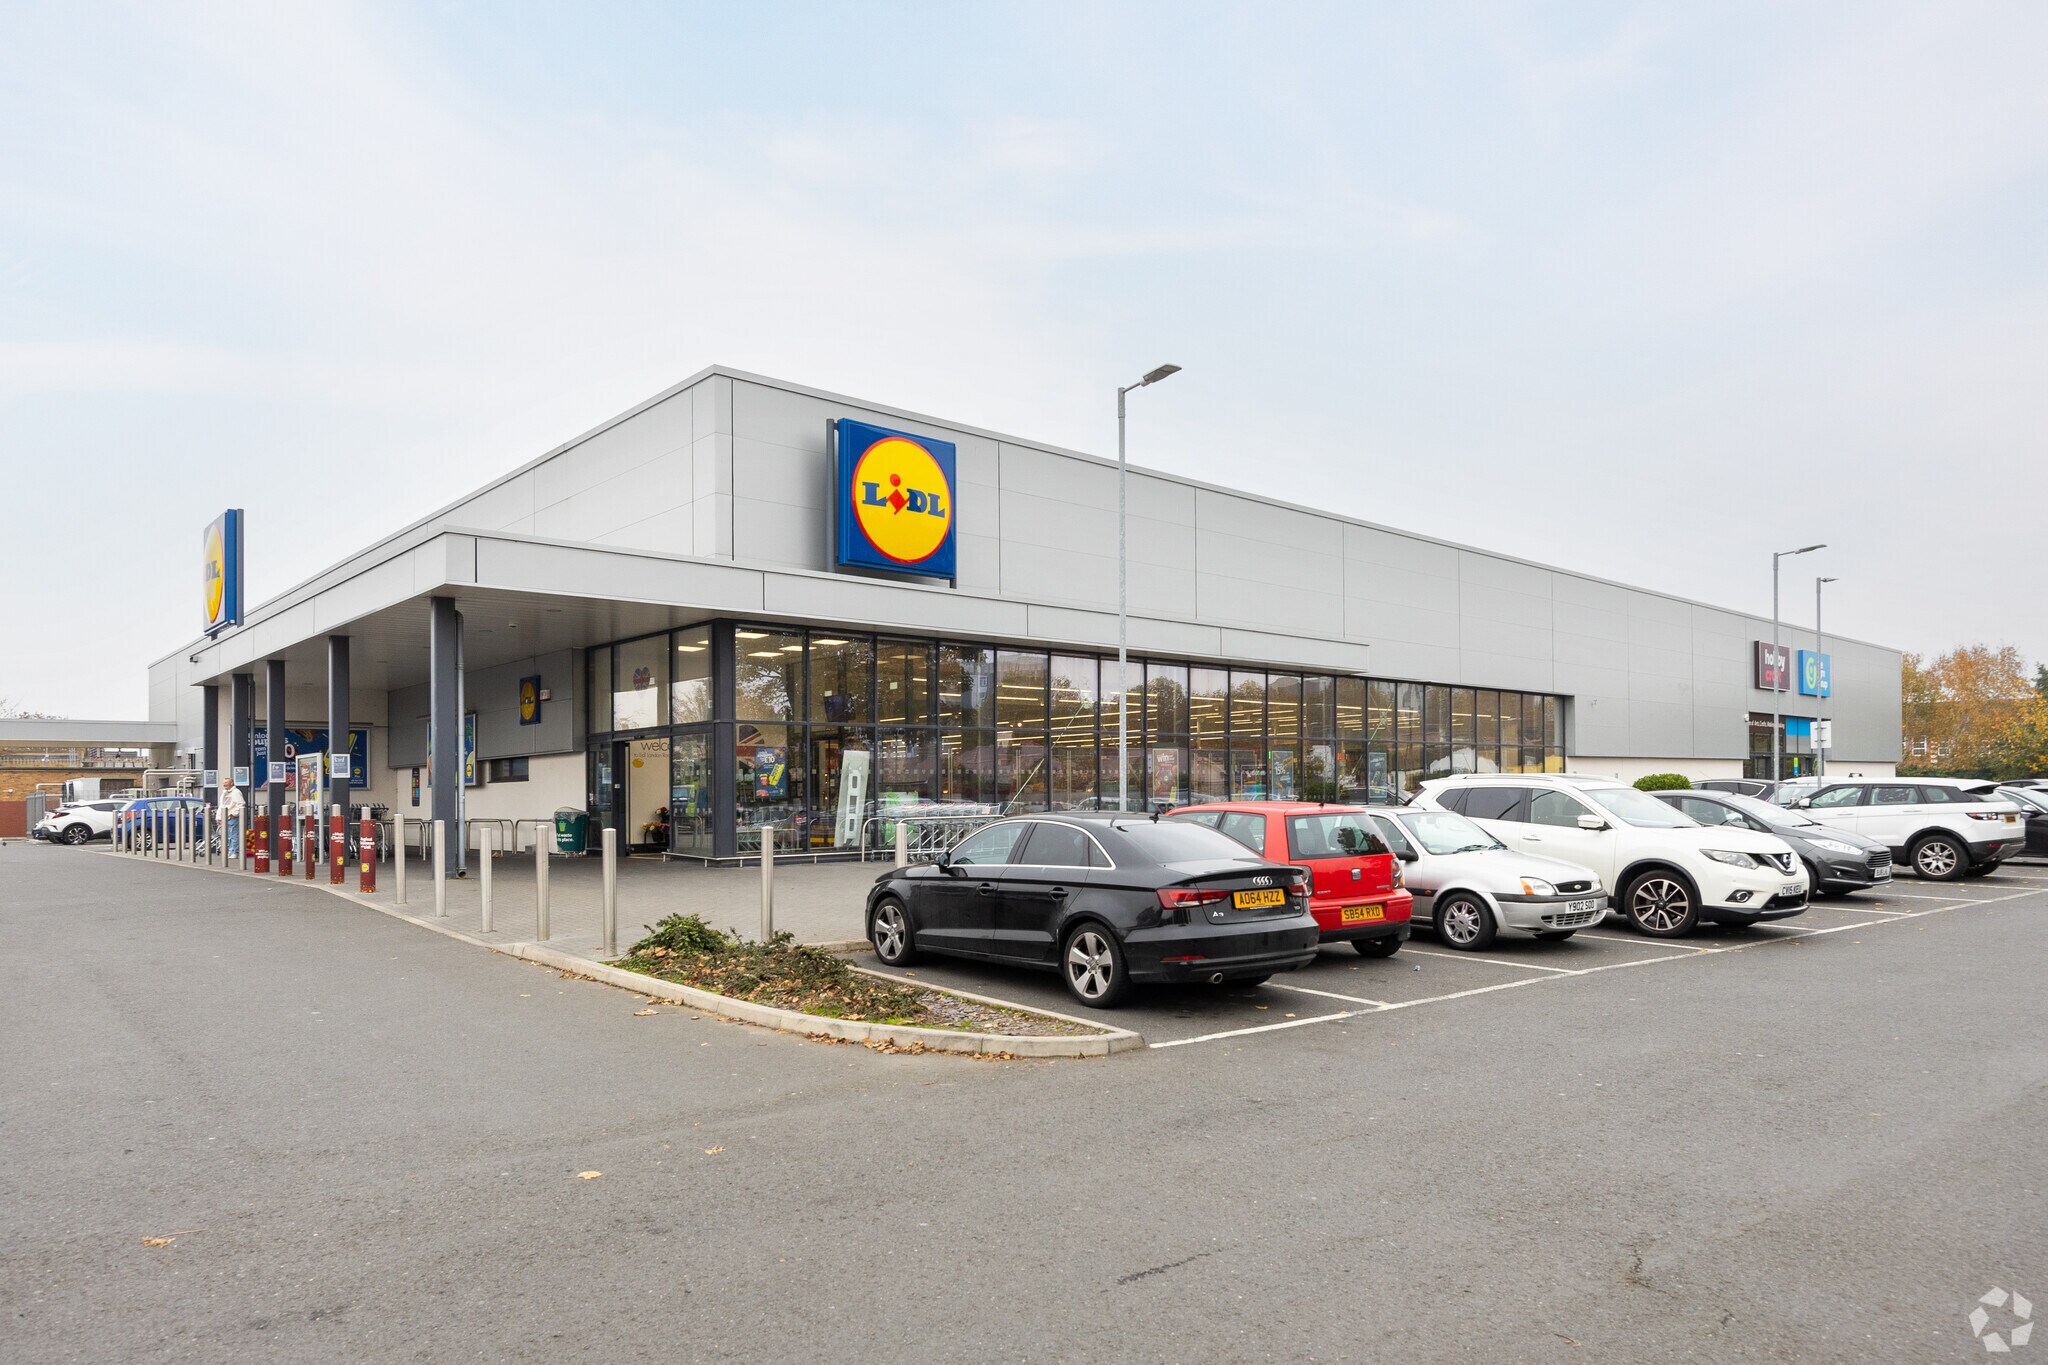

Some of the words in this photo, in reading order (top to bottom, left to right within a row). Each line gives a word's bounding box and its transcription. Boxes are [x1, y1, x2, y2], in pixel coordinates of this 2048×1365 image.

[1765, 649, 1785, 672] hoby
[1264, 891, 1281, 903] HZZ
[1568, 901, 1584, 911] Y902
[1344, 909, 1365, 920] SB54
